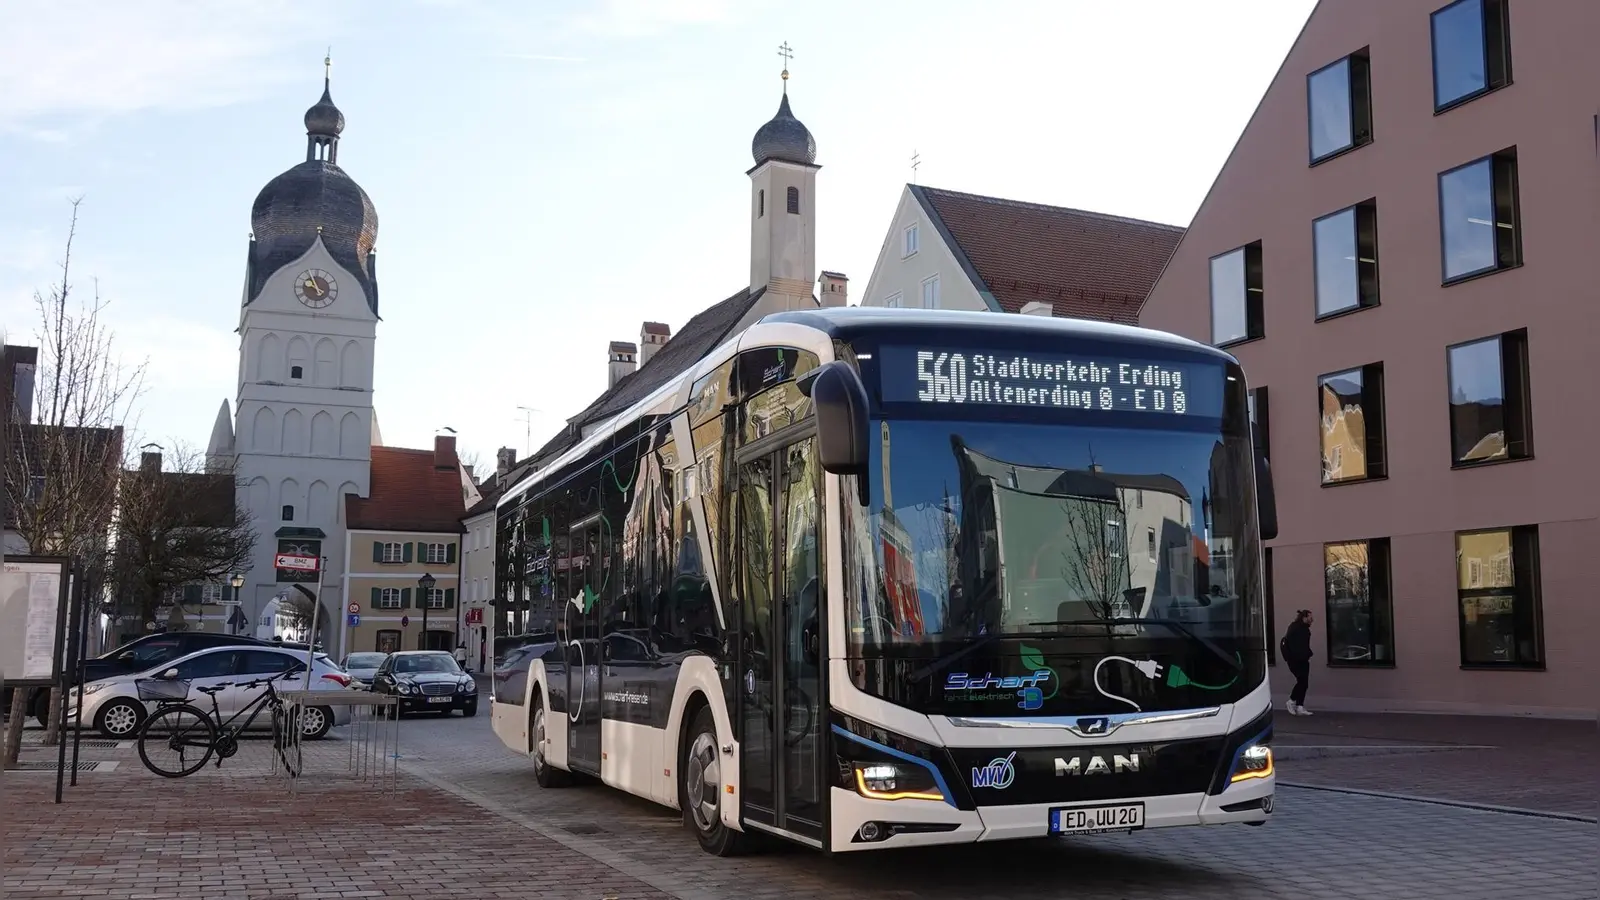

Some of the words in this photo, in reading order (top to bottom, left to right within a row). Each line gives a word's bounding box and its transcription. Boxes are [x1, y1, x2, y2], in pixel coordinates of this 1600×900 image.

[918, 351, 967, 403] 560
[973, 355, 1111, 383] Stadtverkehr
[1119, 363, 1182, 389] Erding
[704, 381, 720, 398] MAN
[970, 380, 1092, 409] Altenerding
[944, 670, 1051, 690] Scharf
[1054, 753, 1140, 777] MAN
[1066, 811, 1086, 829] ED
[1096, 808, 1116, 826] UU
[1119, 807, 1137, 825] 20
